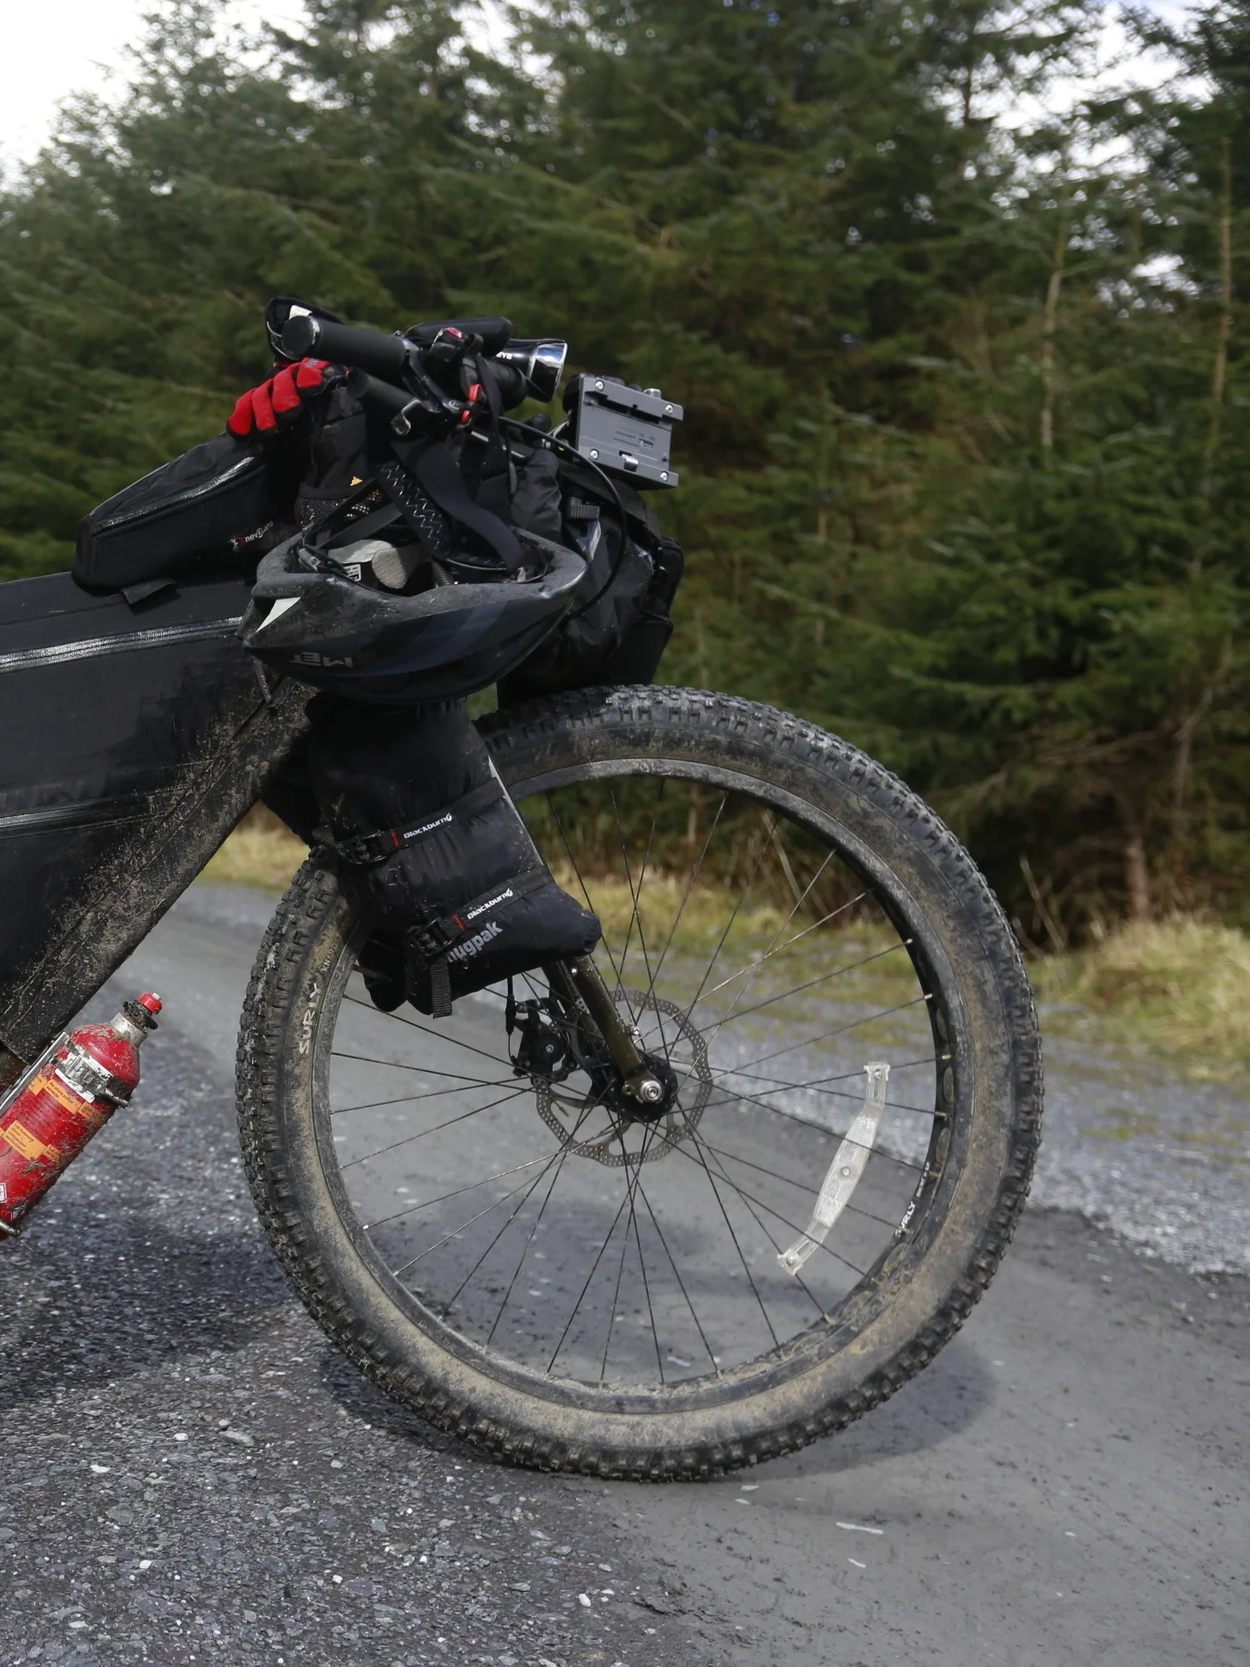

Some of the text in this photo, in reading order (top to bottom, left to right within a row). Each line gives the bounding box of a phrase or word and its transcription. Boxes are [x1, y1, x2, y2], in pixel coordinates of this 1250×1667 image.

[290, 652, 354, 667] MET
[403, 816, 448, 839] Blackburn
[467, 891, 509, 920] Blackburn
[446, 921, 503, 963] nugpak
[299, 982, 320, 1055] SURLY
